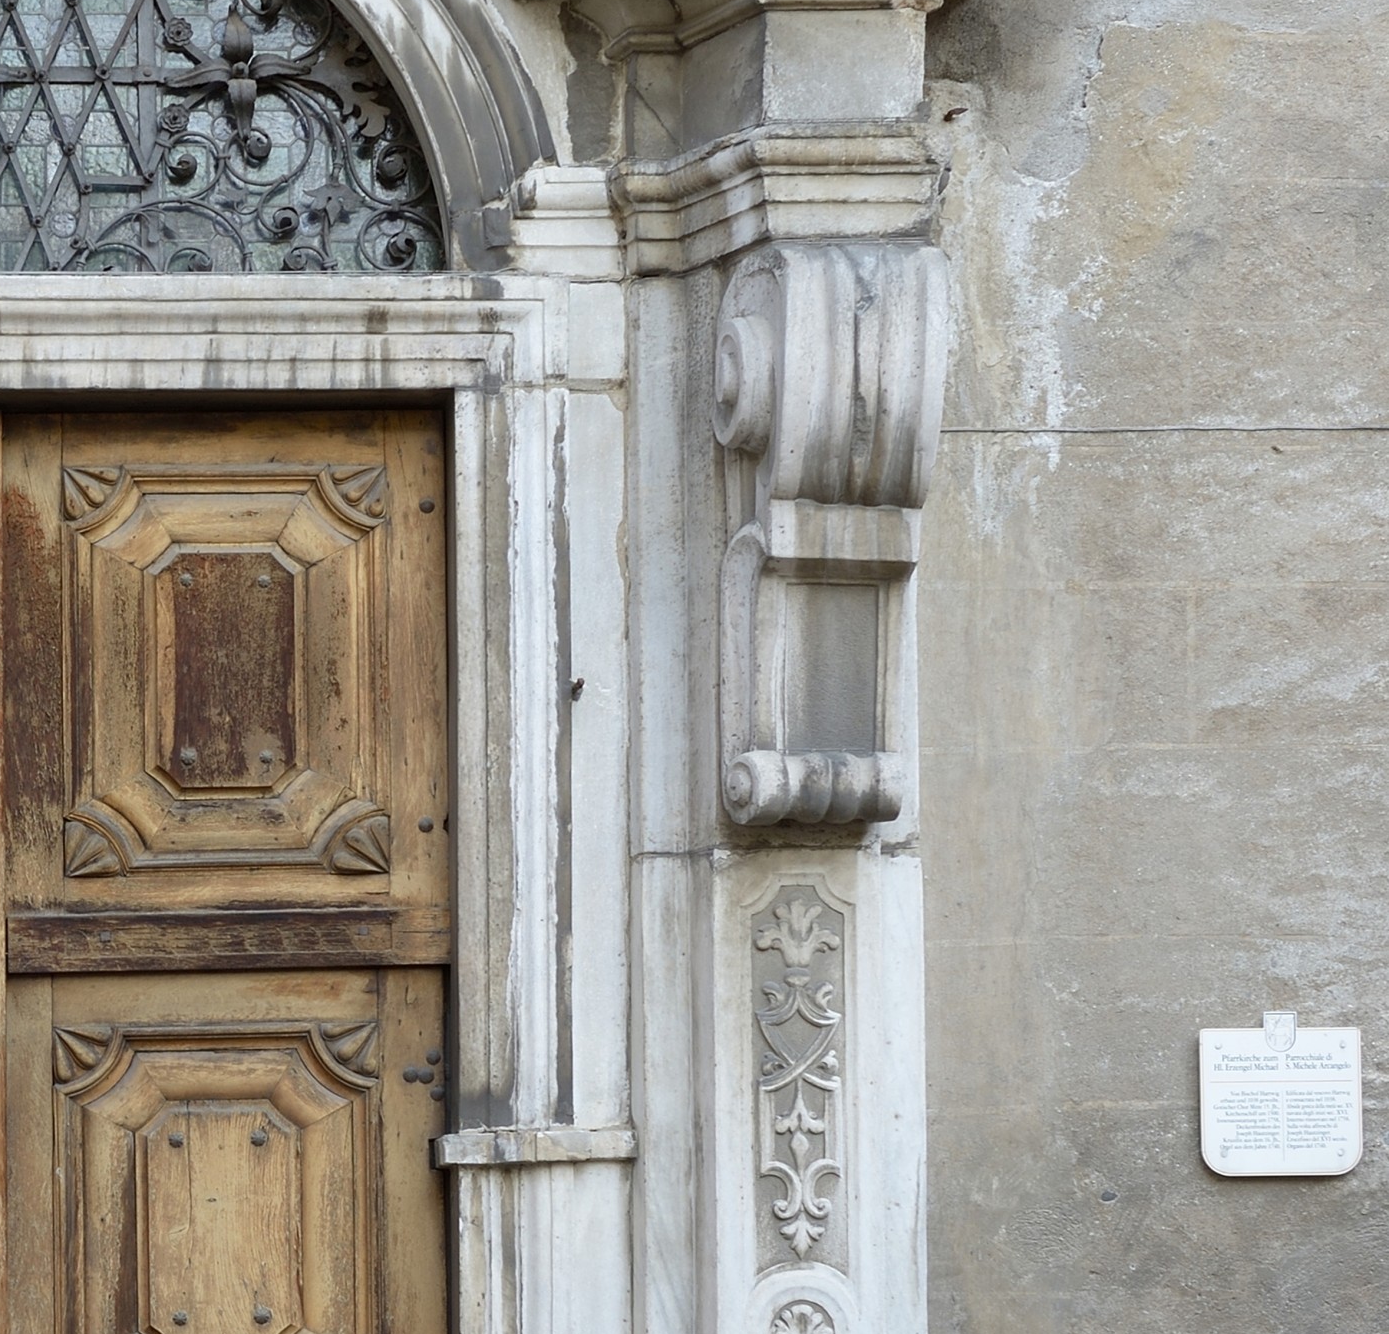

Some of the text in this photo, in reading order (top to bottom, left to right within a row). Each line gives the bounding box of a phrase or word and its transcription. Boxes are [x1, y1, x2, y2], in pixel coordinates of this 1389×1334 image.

[1222, 1054, 1260, 1062] Pfarrkirche
[1285, 1053, 1333, 1061] Parrocchiale di
[1226, 1063, 1252, 1073] Erzengel
[1254, 1063, 1279, 1071] Michael
[1285, 1062, 1352, 1071] S. Michele Arcangelo
